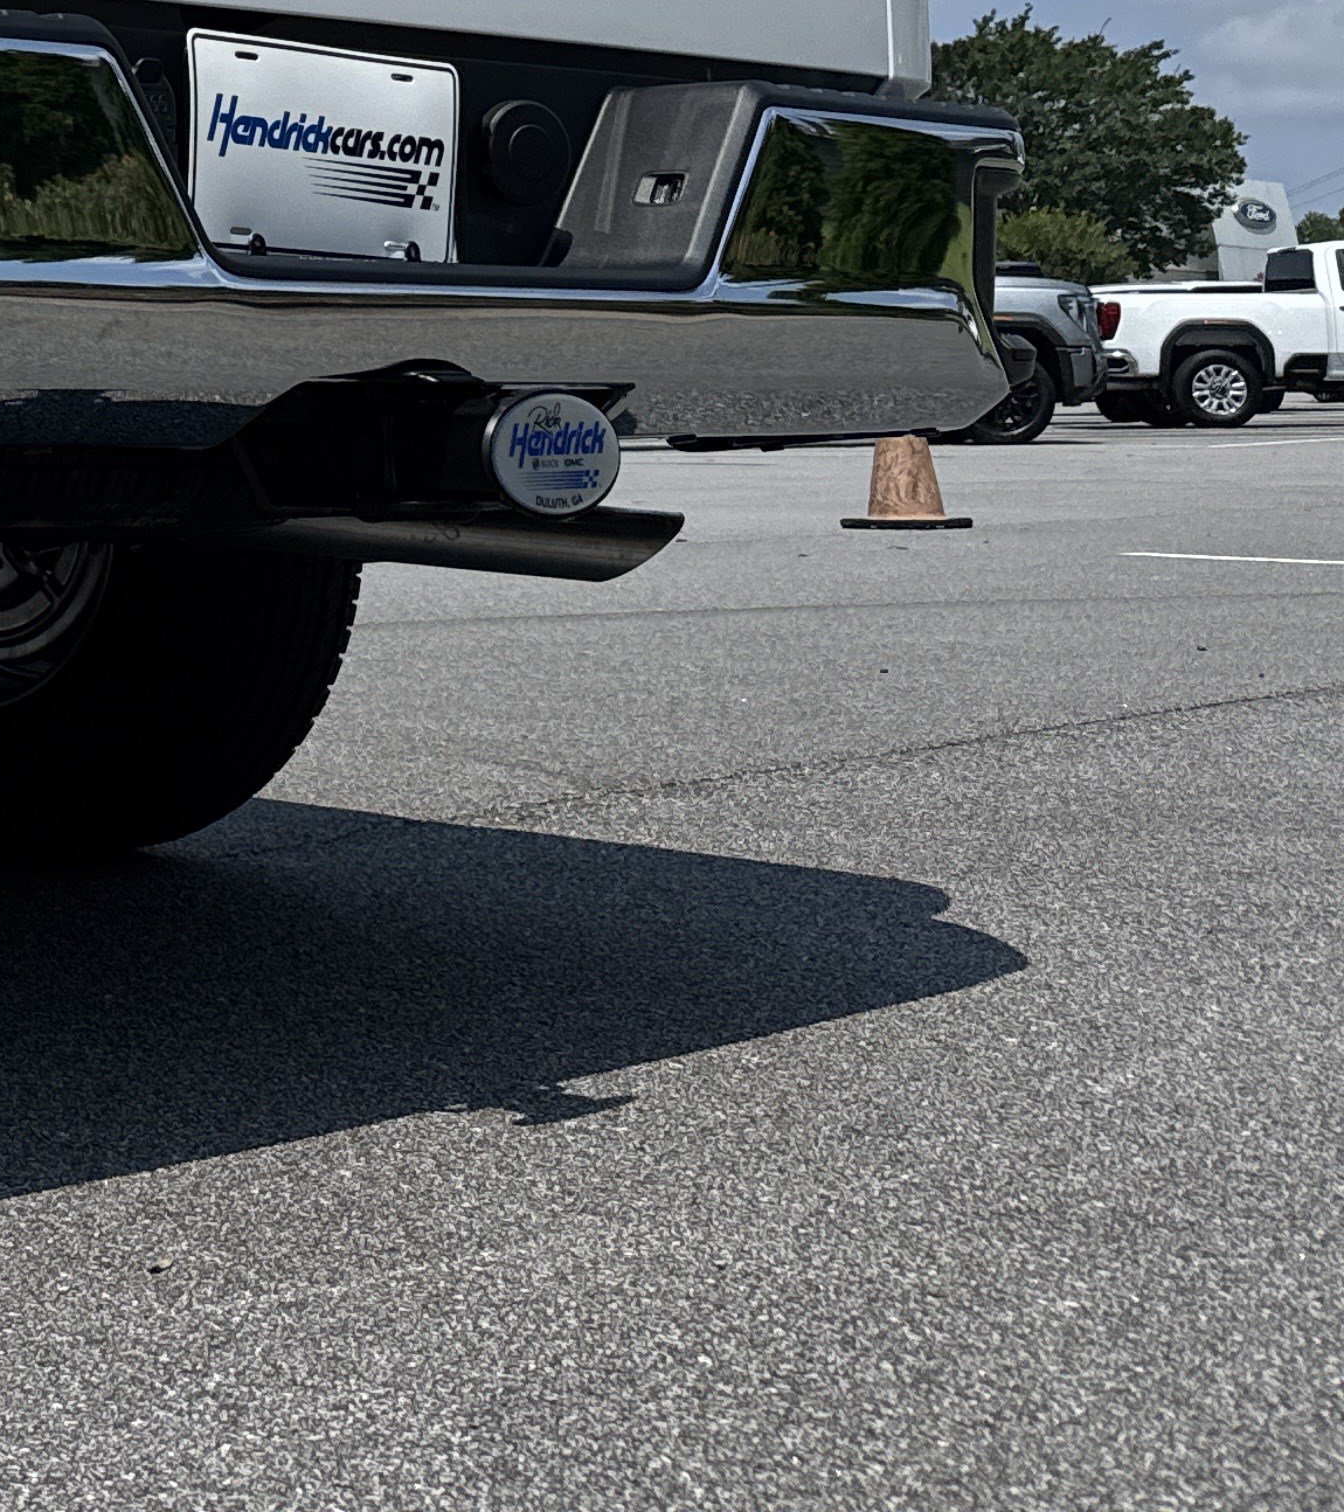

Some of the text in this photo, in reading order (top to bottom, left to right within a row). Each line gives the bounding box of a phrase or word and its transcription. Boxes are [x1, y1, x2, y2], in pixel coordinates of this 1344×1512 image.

[207, 93, 445, 167] Hendrickcars.com
[1247, 204, 1270, 221] Ford
[509, 421, 606, 469] Hendrick
